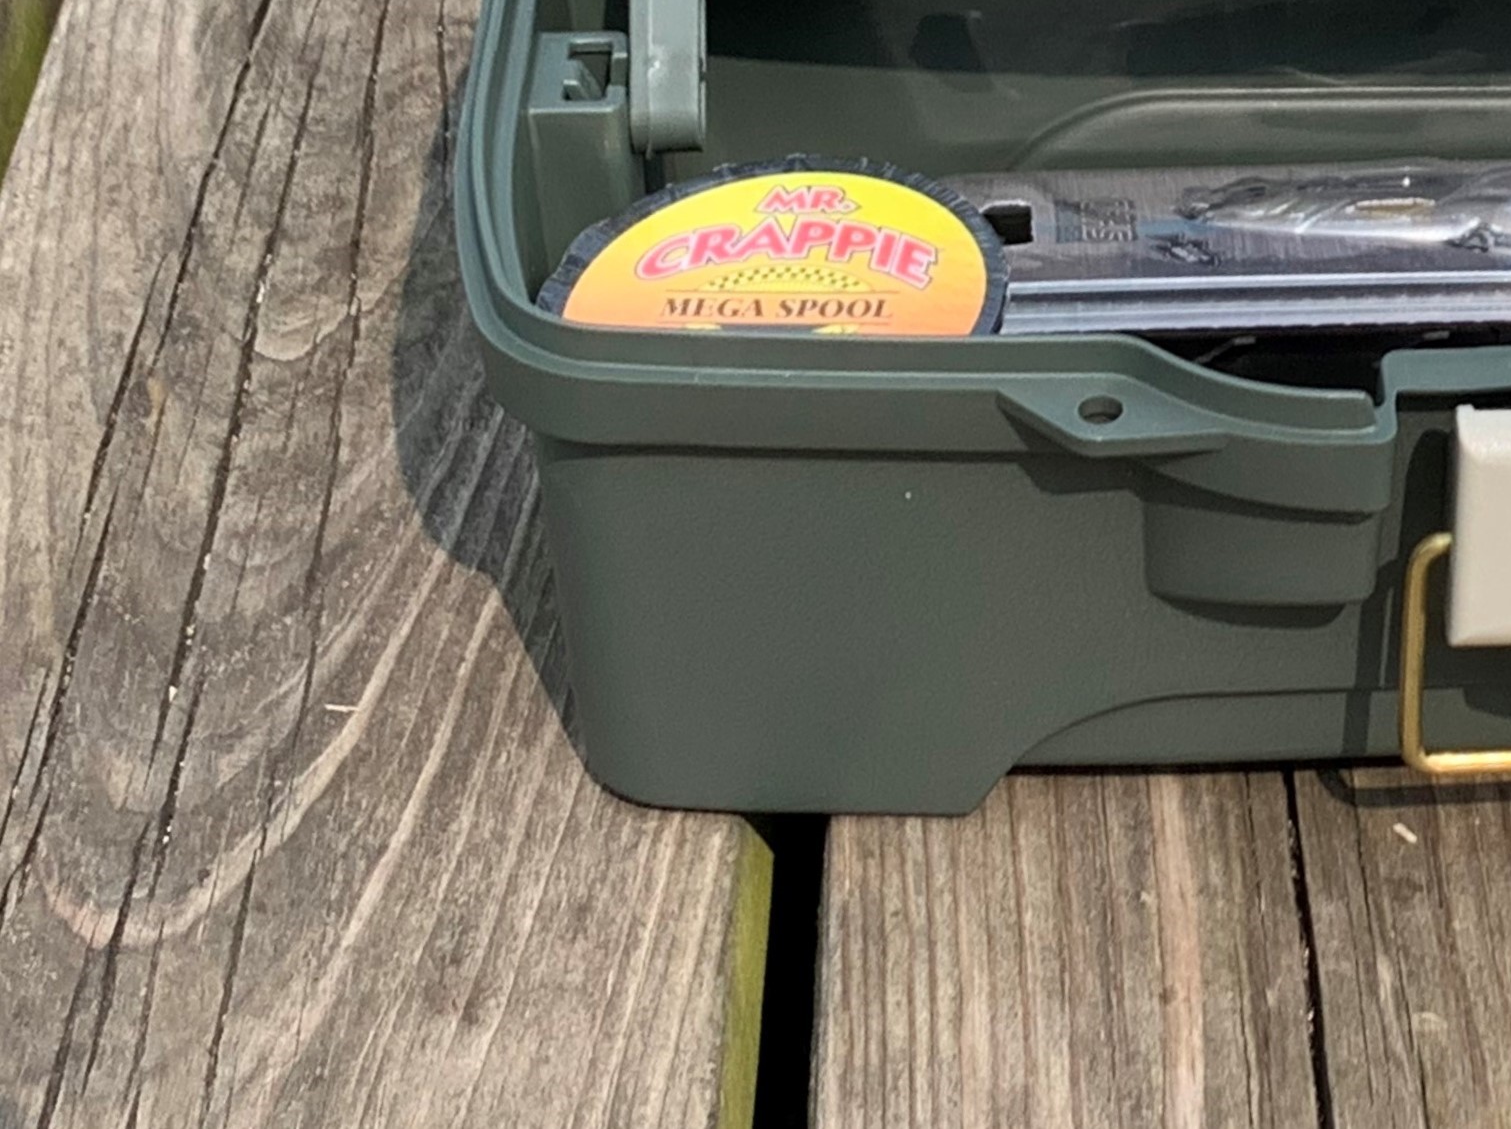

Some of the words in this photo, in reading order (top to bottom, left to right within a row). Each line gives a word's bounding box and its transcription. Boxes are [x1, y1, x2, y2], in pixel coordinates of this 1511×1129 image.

[757, 185, 860, 214] MR.
[636, 218, 938, 290] CRAPPIE
[660, 298, 765, 318] MEGA
[775, 298, 894, 319] SPOOL
